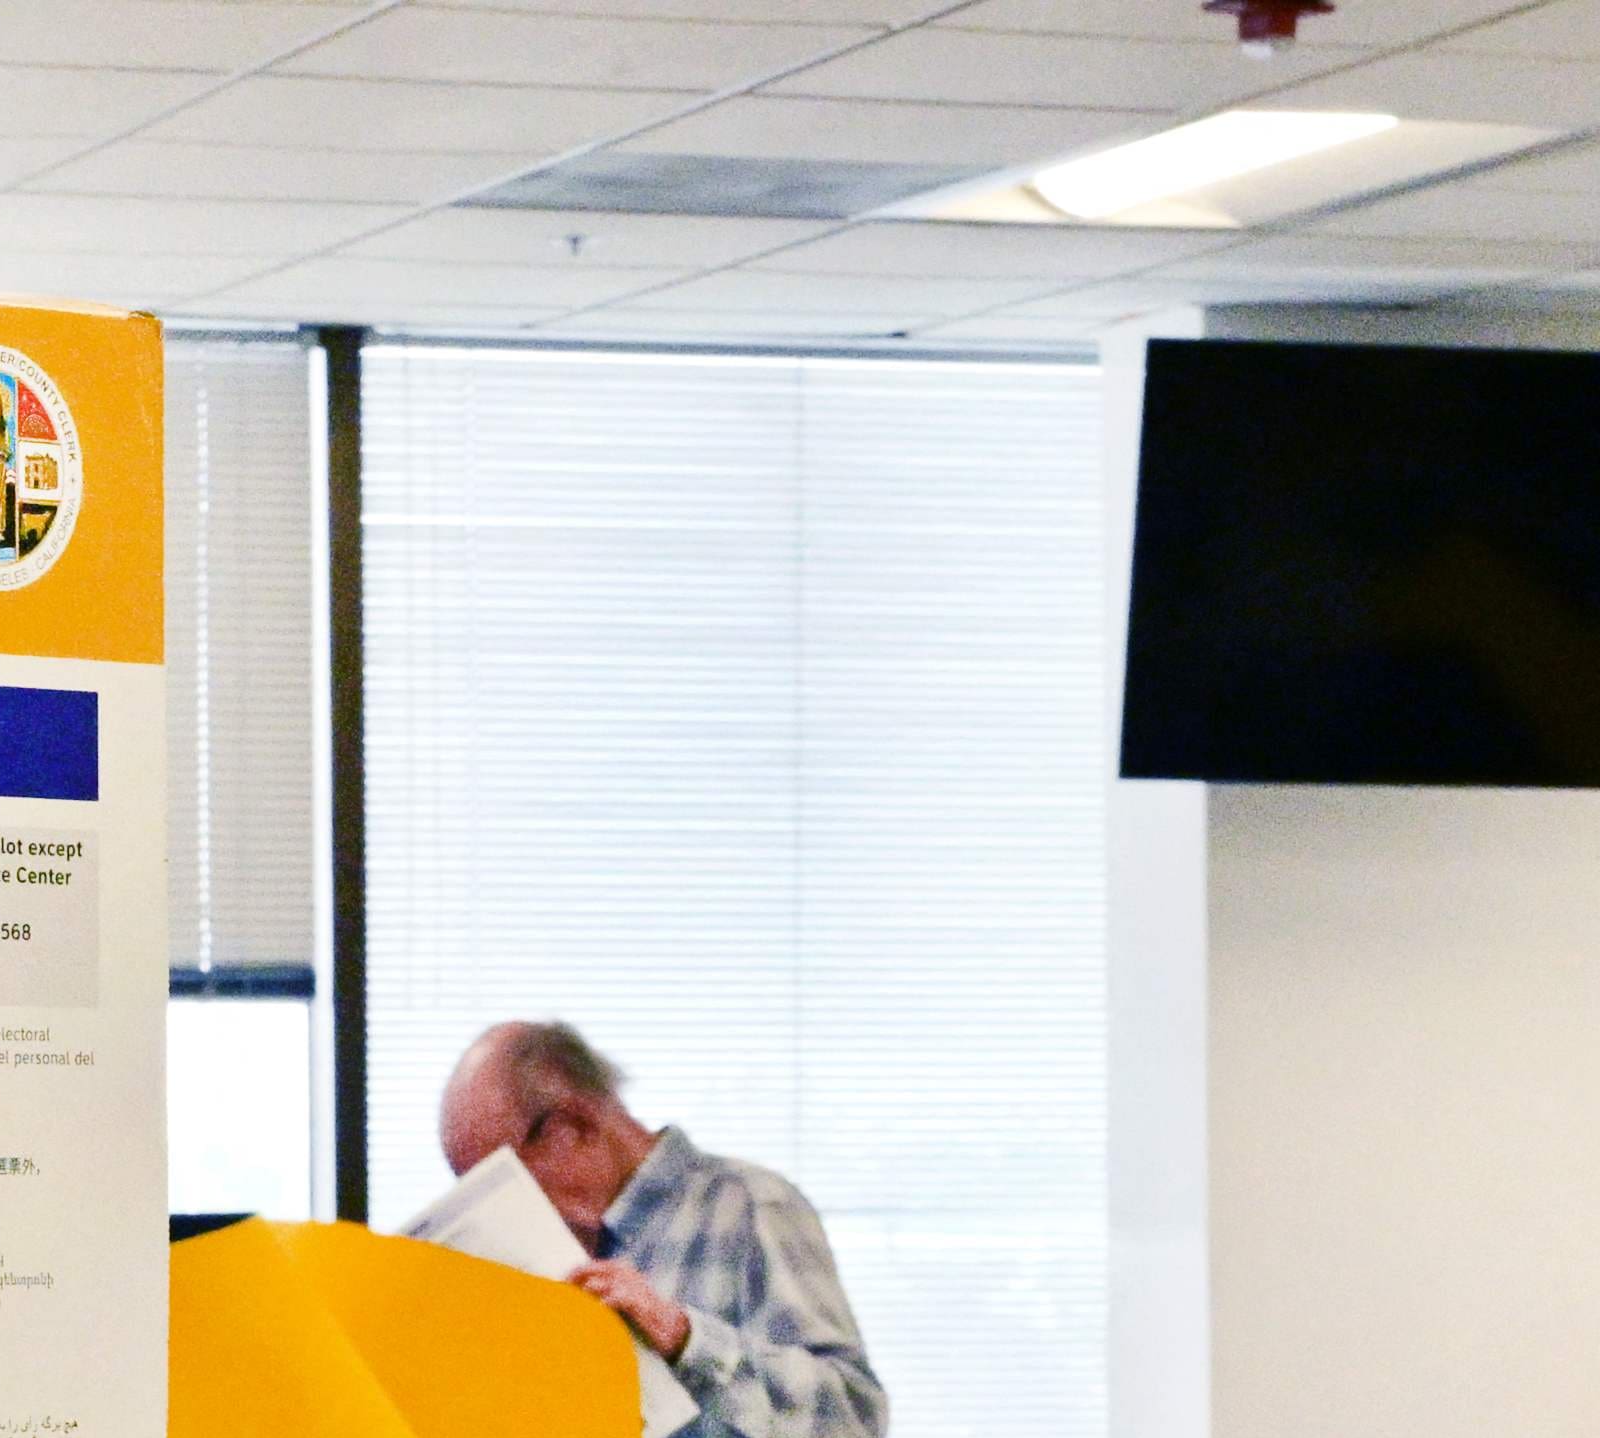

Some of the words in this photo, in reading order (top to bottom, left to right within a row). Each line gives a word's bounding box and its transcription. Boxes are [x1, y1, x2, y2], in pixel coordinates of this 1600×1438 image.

[60, 411, 77, 461] CLERK
[29, 842, 82, 861] except
[17, 867, 71, 885] Center
